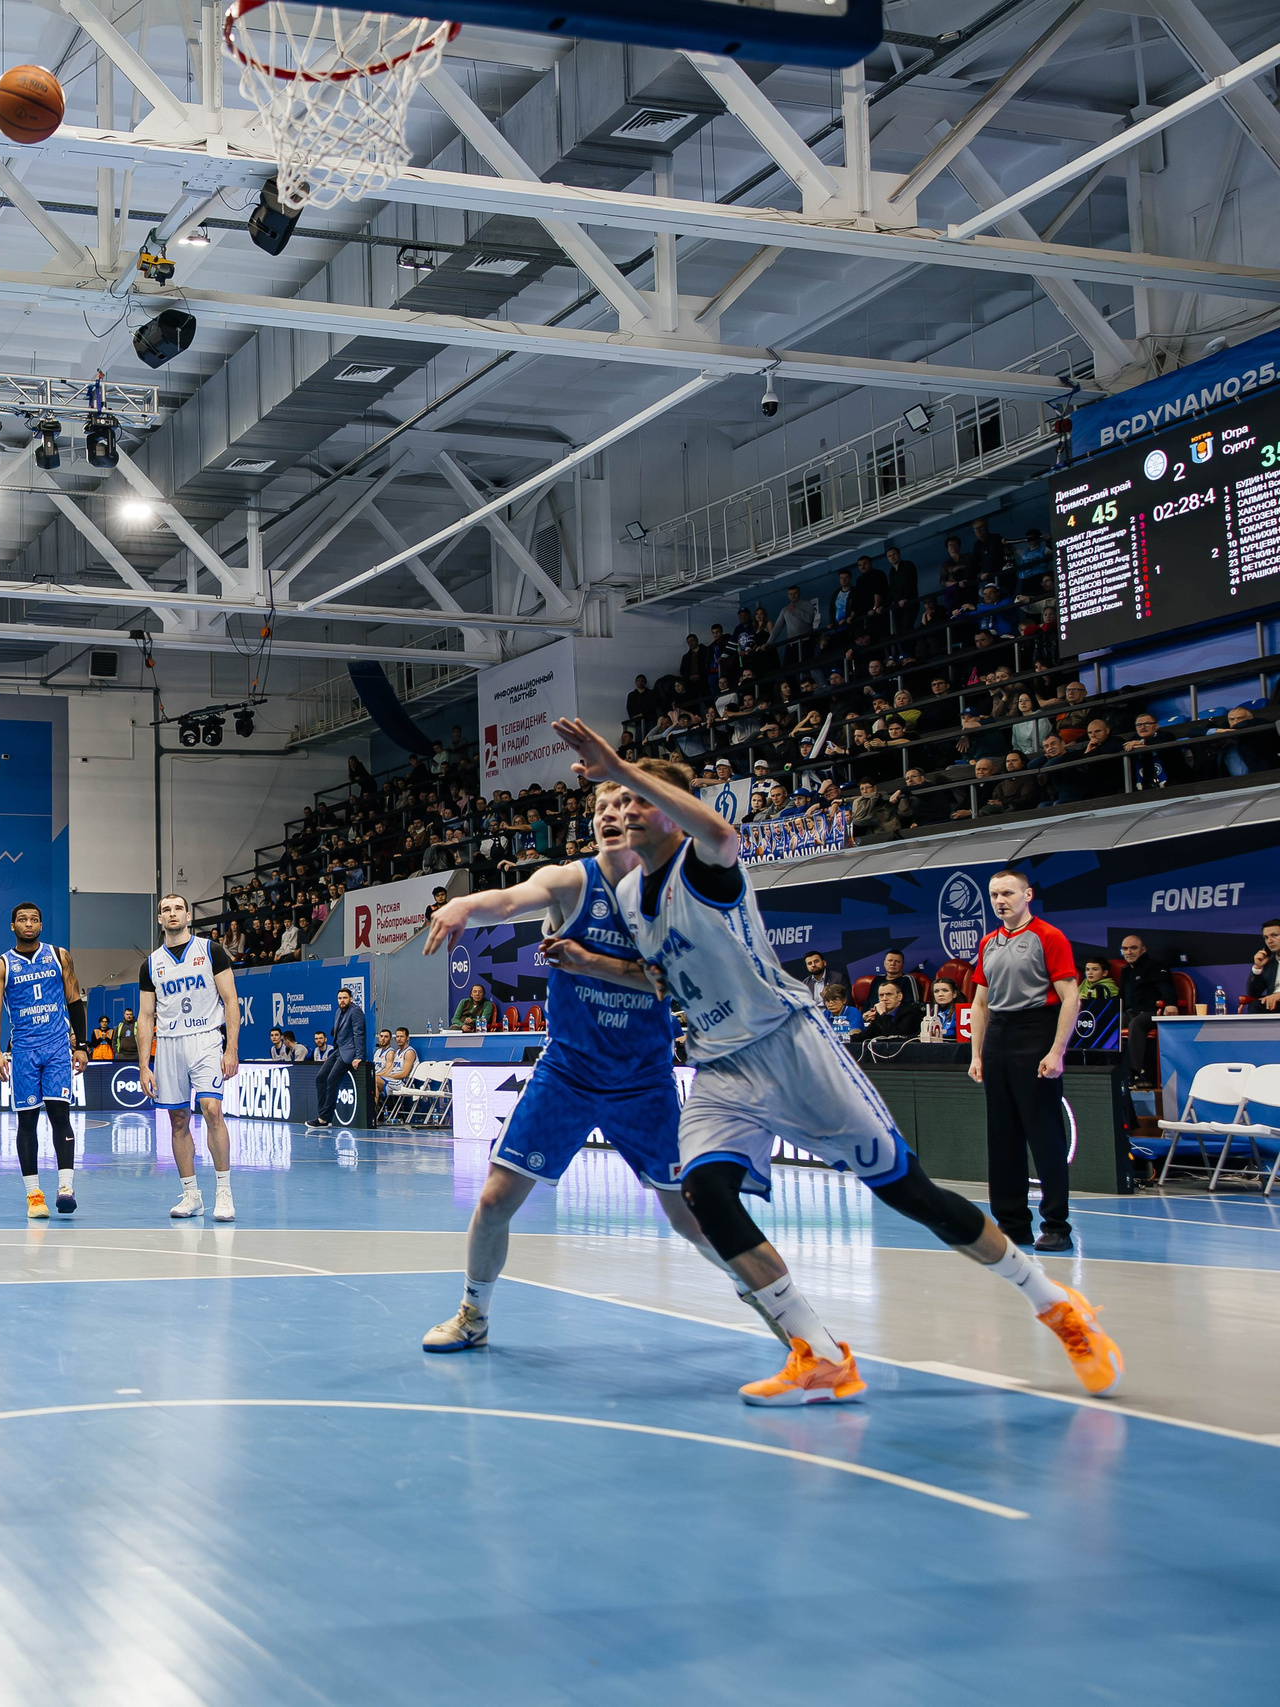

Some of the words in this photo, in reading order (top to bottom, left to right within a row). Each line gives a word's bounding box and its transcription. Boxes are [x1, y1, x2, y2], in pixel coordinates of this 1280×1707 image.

[1221, 425, 1249, 441] Югра
[1222, 436, 1256, 455] Сургут
[1260, 441, 1280, 468] 3
[1173, 462, 1186, 482] 2
[1055, 484, 1089, 504] Динамо
[1056, 487, 1109, 514] Приморский
[1109, 479, 1132, 496] край
[1091, 500, 1118, 525] 45
[1153, 487, 1216, 522] 02:28:4
[1067, 514, 1076, 527] 4
[1211, 547, 1220, 559] 2
[493, 670, 554, 701] ИНФОРМАЦИОННЫЙ
[500, 711, 547, 736] ТЕЛЕВИДЕНИЕ
[501, 741, 507, 753] И
[507, 734, 530, 752] РАДИО
[501, 745, 551, 770] ПРИМОРСКОГО
[177, 868, 184, 877] 4
[1150, 882, 1246, 913] FONBET
[376, 902, 400, 917] Русская
[949, 919, 976, 929] FONBET
[376, 932, 408, 945] Компания
[764, 925, 814, 946] ONBET
[949, 930, 979, 950] СУПЕР
[451, 960, 468, 974] РФБ
[13, 969, 57, 985] ДИНАМО
[160, 973, 207, 997] ЮГРА
[32, 983, 43, 1001] 0
[286, 992, 305, 1003] Русская
[574, 985, 655, 1010] ПРИМОРСКИЙ
[19, 1001, 59, 1018] ПРИМОРСКИЙ
[180, 996, 193, 1015] 6
[287, 1003, 332, 1016] Рыбопромышленная
[32, 1013, 50, 1025] КРАЙ
[184, 1016, 209, 1028] Utair
[287, 1016, 310, 1026] Компания
[597, 1009, 629, 1029] КРАЙ
[696, 999, 735, 1032] Utair
[1077, 1019, 1094, 1029] РФБ
[238, 1067, 291, 1120] 2025/26
